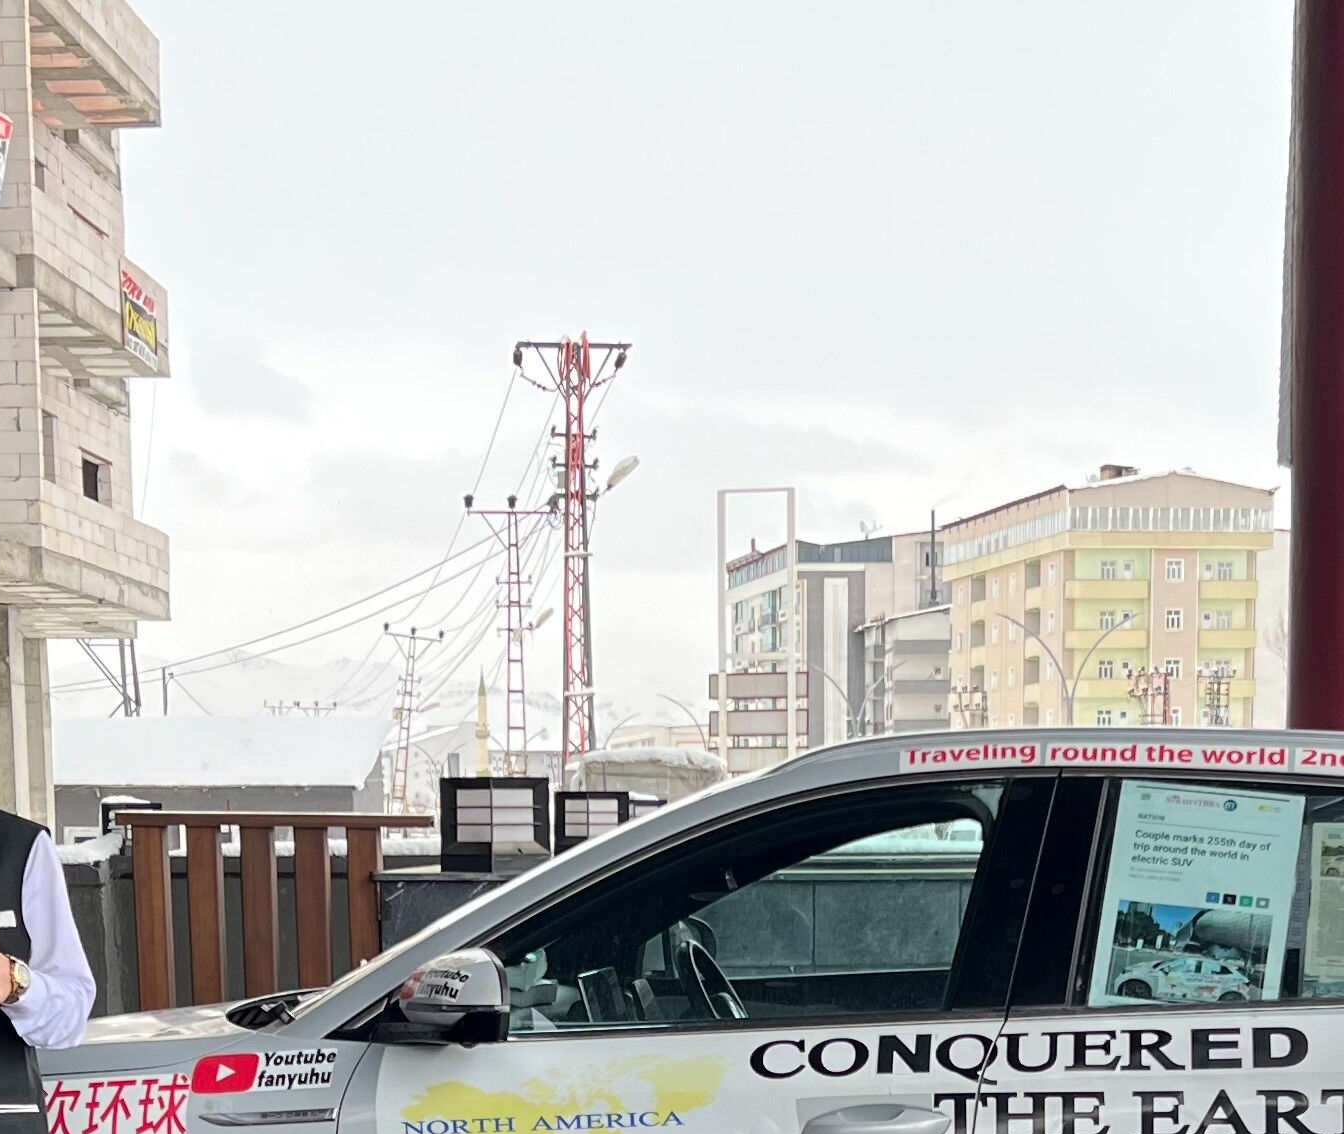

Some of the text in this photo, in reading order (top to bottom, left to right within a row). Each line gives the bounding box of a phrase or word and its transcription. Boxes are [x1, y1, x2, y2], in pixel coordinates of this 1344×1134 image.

[907, 743, 1036, 765] Traveling
[1050, 744, 1137, 763] round
[1146, 745, 1193, 763] the
[1201, 747, 1286, 766] world
[1133, 842, 1250, 861] trip around the world in
[1135, 829, 1272, 852] Couple marks 255th day of
[1131, 854, 1194, 867] electric SUV
[264, 1049, 337, 1066] Youtube
[749, 1027, 1309, 1085] CONQUERED
[257, 1068, 333, 1090] fanyuhu
[530, 1110, 685, 1132] AMERICA
